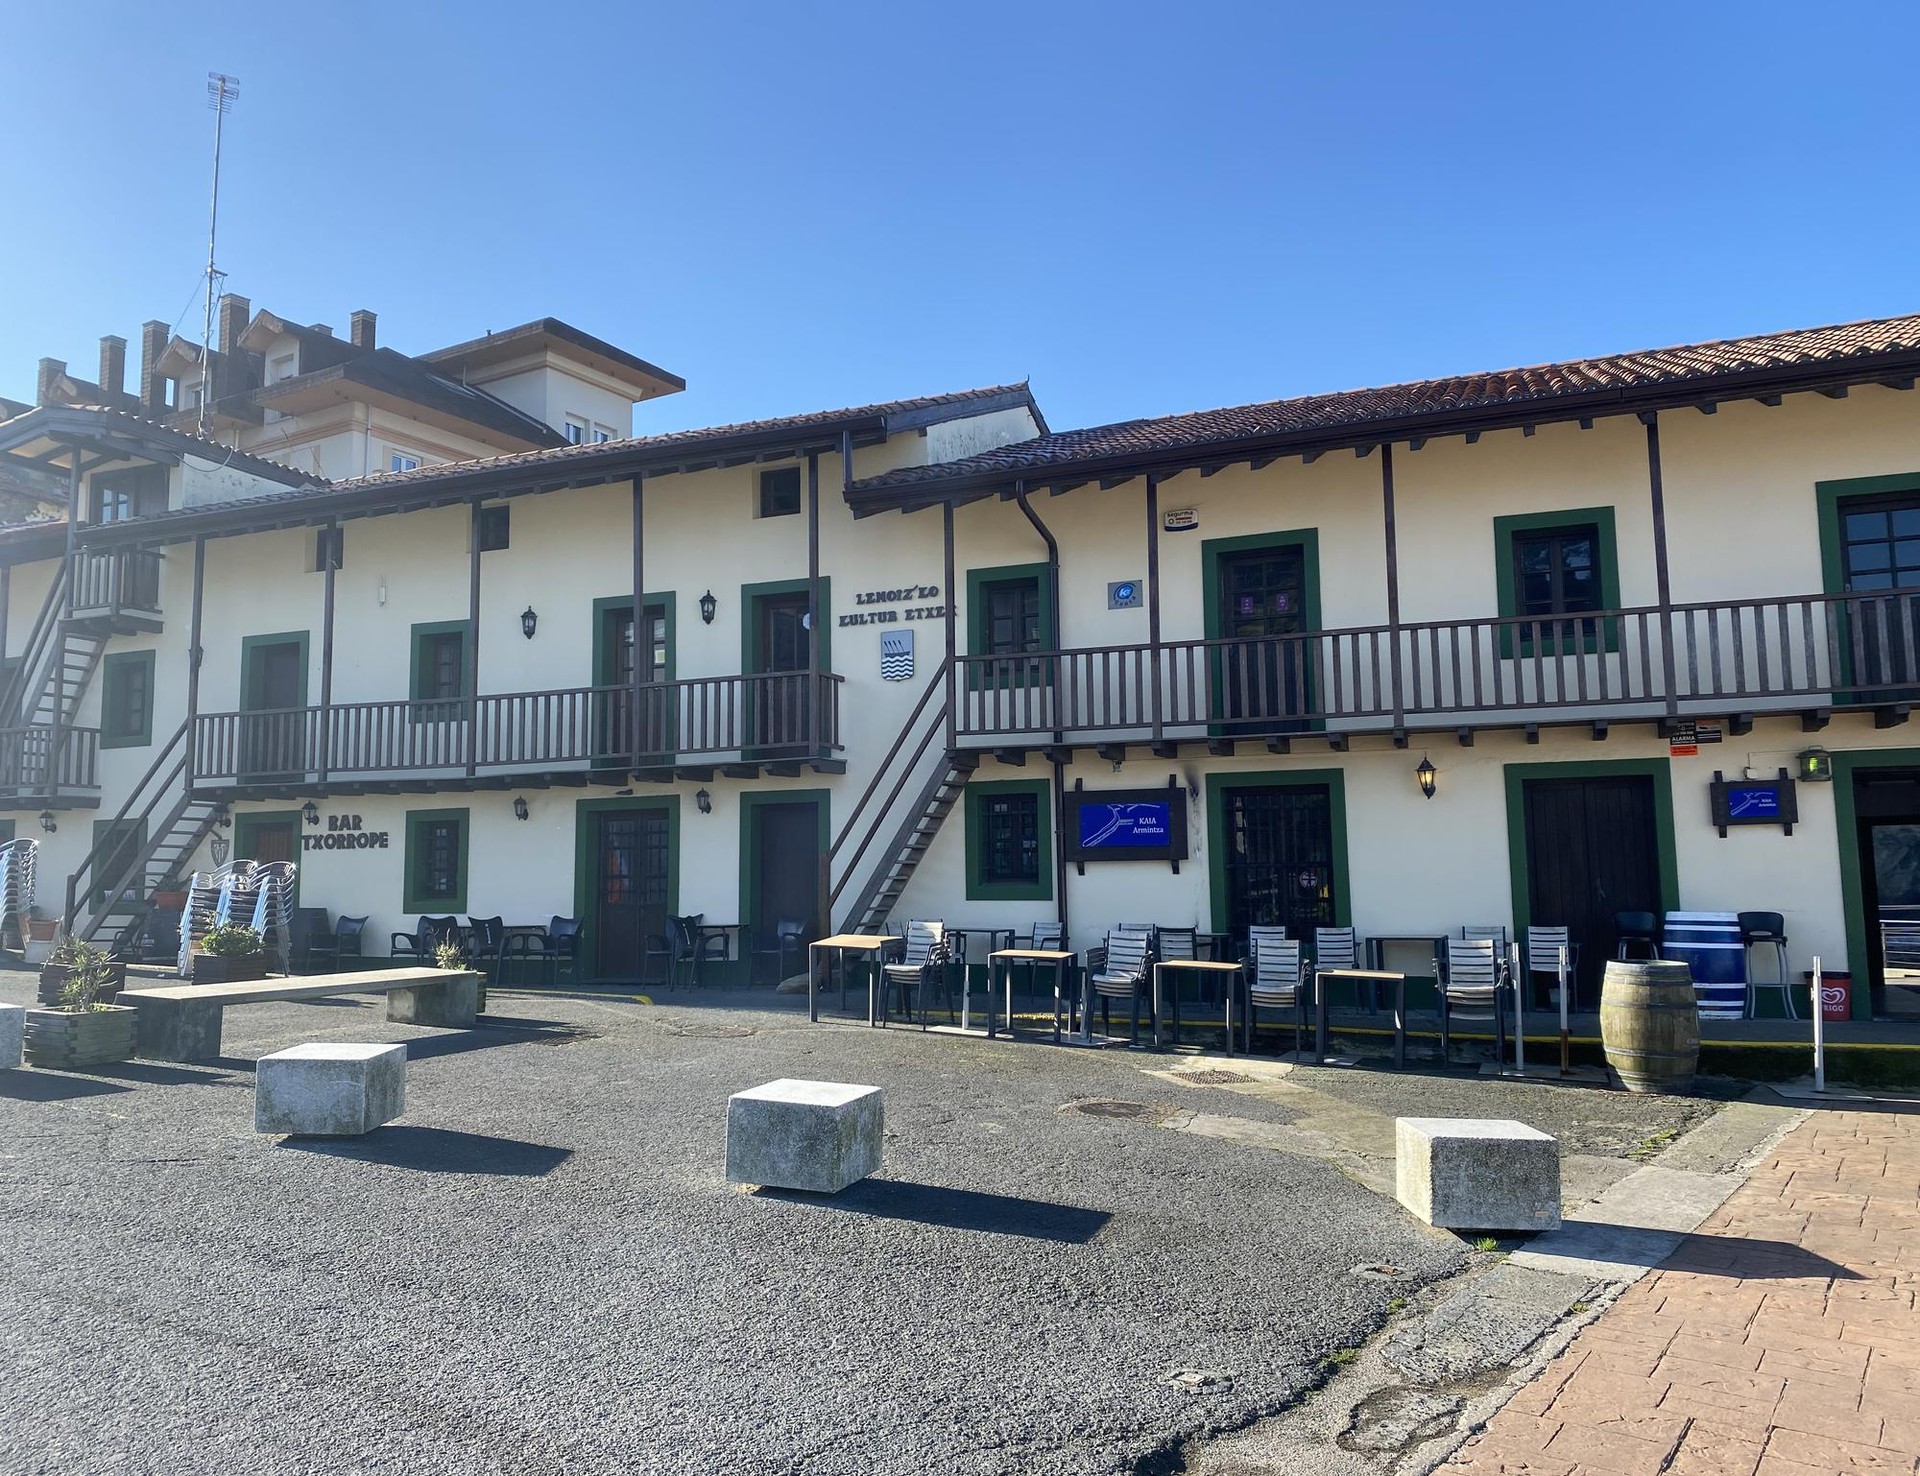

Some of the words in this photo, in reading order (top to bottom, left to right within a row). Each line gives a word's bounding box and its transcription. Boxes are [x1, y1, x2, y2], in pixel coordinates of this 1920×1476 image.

[839, 611, 898, 627] KULTUR
[905, 605, 957, 621] ETXE
[328, 815, 363, 831] BAR
[1139, 817, 1157, 825] KAIA
[302, 832, 389, 851] TXORROPE
[1823, 1004, 1844, 1012] RIGO
